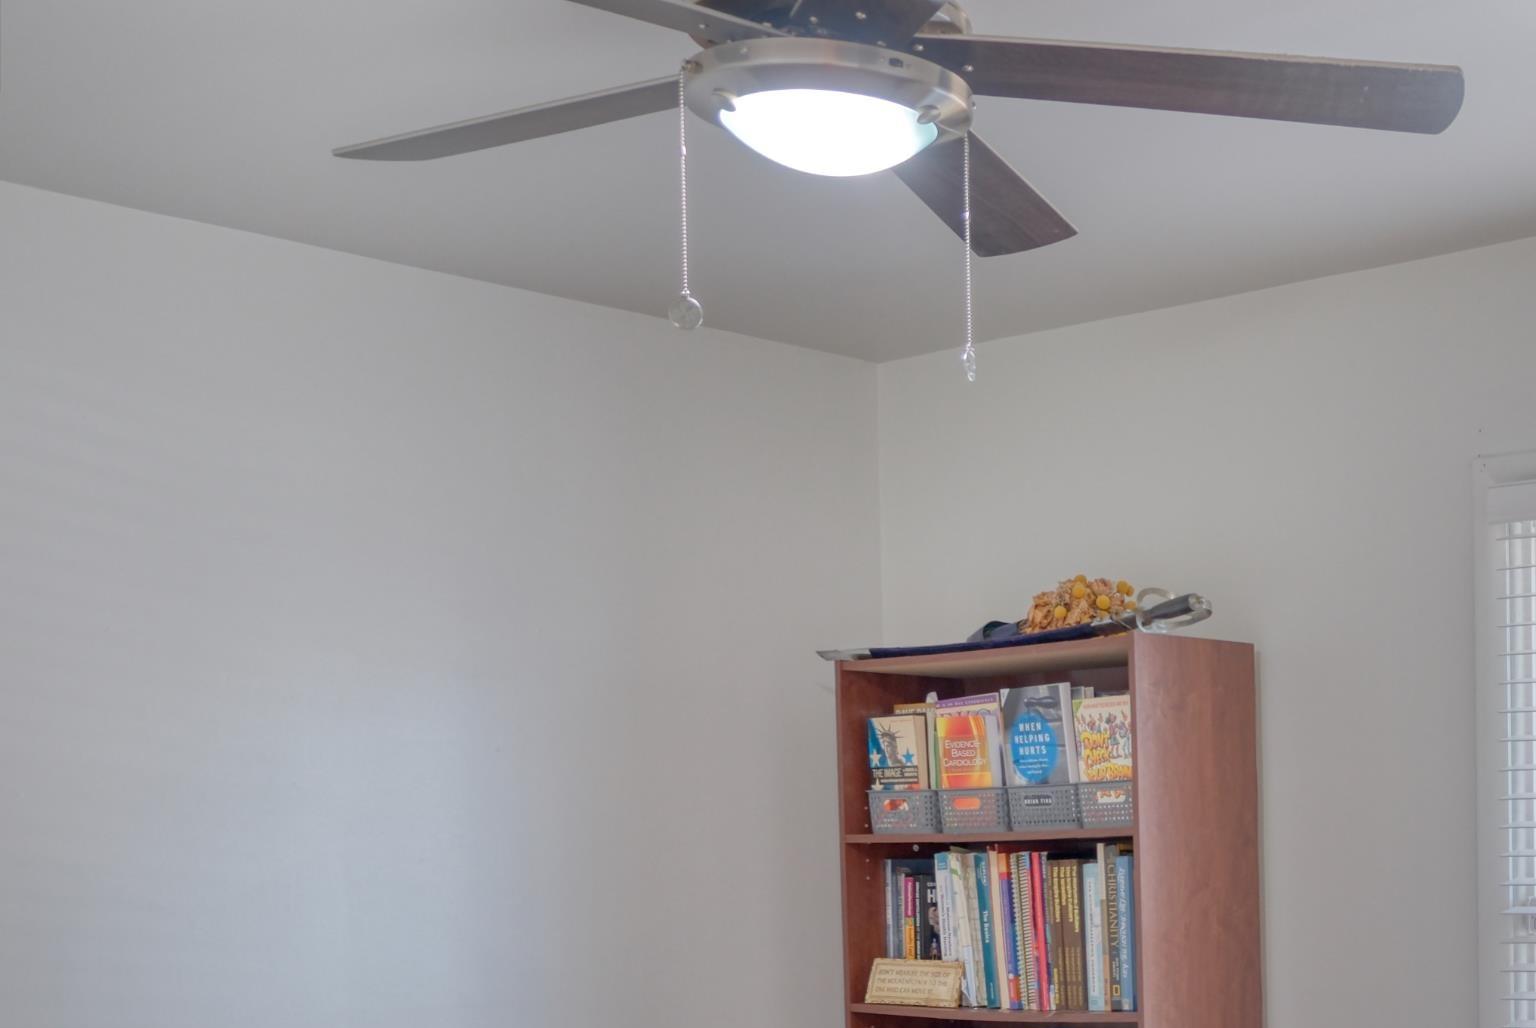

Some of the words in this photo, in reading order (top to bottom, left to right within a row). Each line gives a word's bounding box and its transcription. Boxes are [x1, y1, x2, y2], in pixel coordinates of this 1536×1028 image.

[1018, 722, 1042, 732] WHEN
[1014, 733, 1050, 745] HELPING
[951, 748, 976, 758] BASED
[1018, 745, 1047, 756] HURTS
[943, 759, 986, 767] CARDIOLOGY
[1107, 864, 1120, 948] CHRISTIANITY
